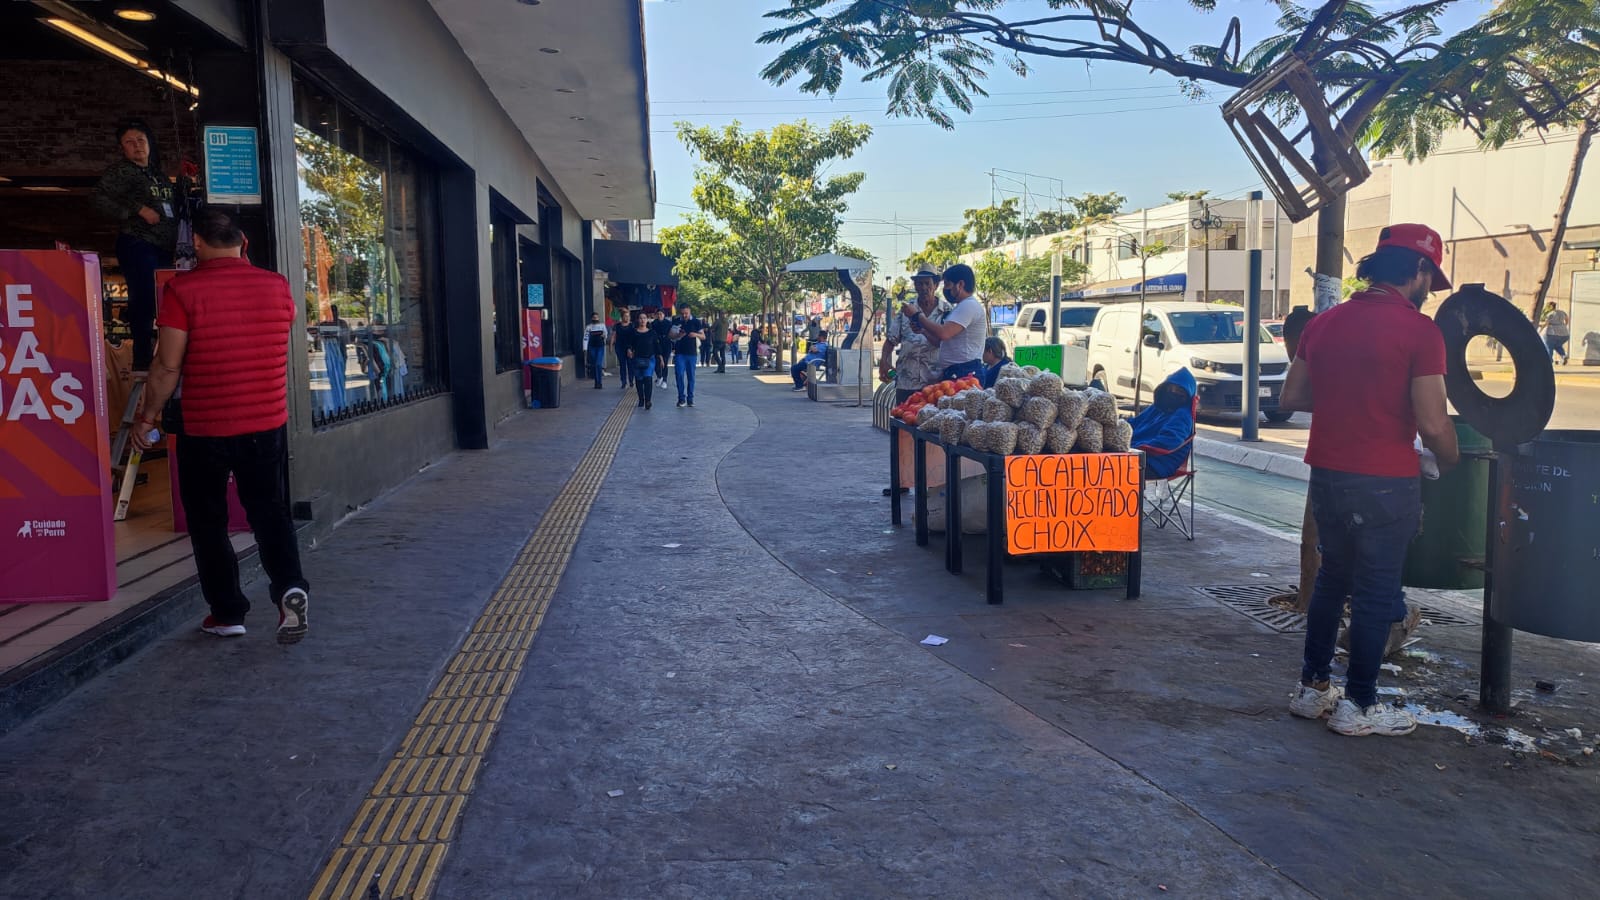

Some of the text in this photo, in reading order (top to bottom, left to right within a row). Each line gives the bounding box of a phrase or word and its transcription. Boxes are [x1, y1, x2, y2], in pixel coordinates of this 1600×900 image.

[211, 134, 226, 144] 911
[0, 284, 34, 327] E
[0, 331, 53, 374] A
[0, 372, 84, 424] A$
[1008, 455, 1139, 487] CACAHUATE
[1008, 487, 1139, 519] RECIEN TOSTADO
[32, 520, 66, 528] Cuidado
[1014, 520, 1095, 550] CHOIX
